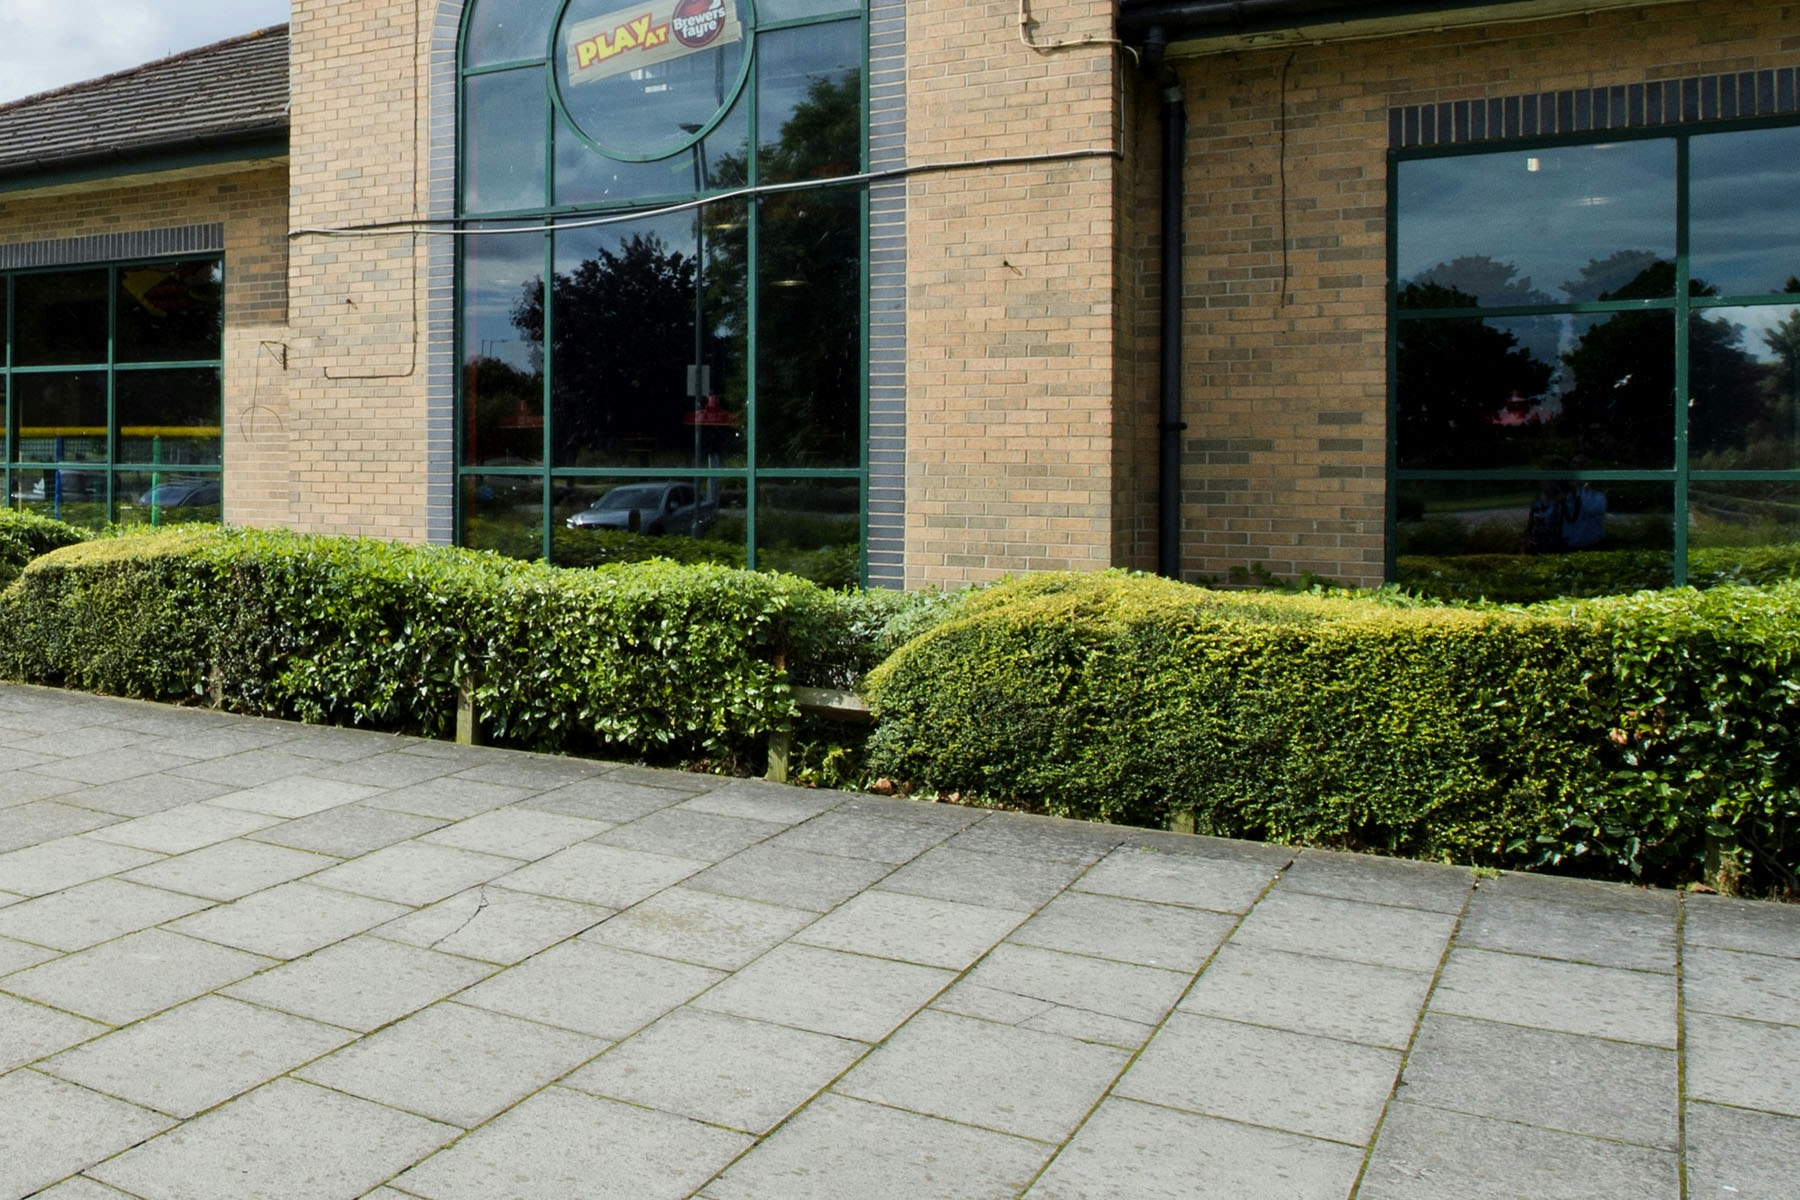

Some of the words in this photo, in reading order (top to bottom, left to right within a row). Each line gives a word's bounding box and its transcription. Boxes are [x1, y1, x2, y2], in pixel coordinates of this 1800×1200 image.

[673, 6, 726, 31] Brewers
[682, 20, 718, 40] fayre
[576, 14, 651, 68] PLAY
[643, 25, 669, 49] AT
